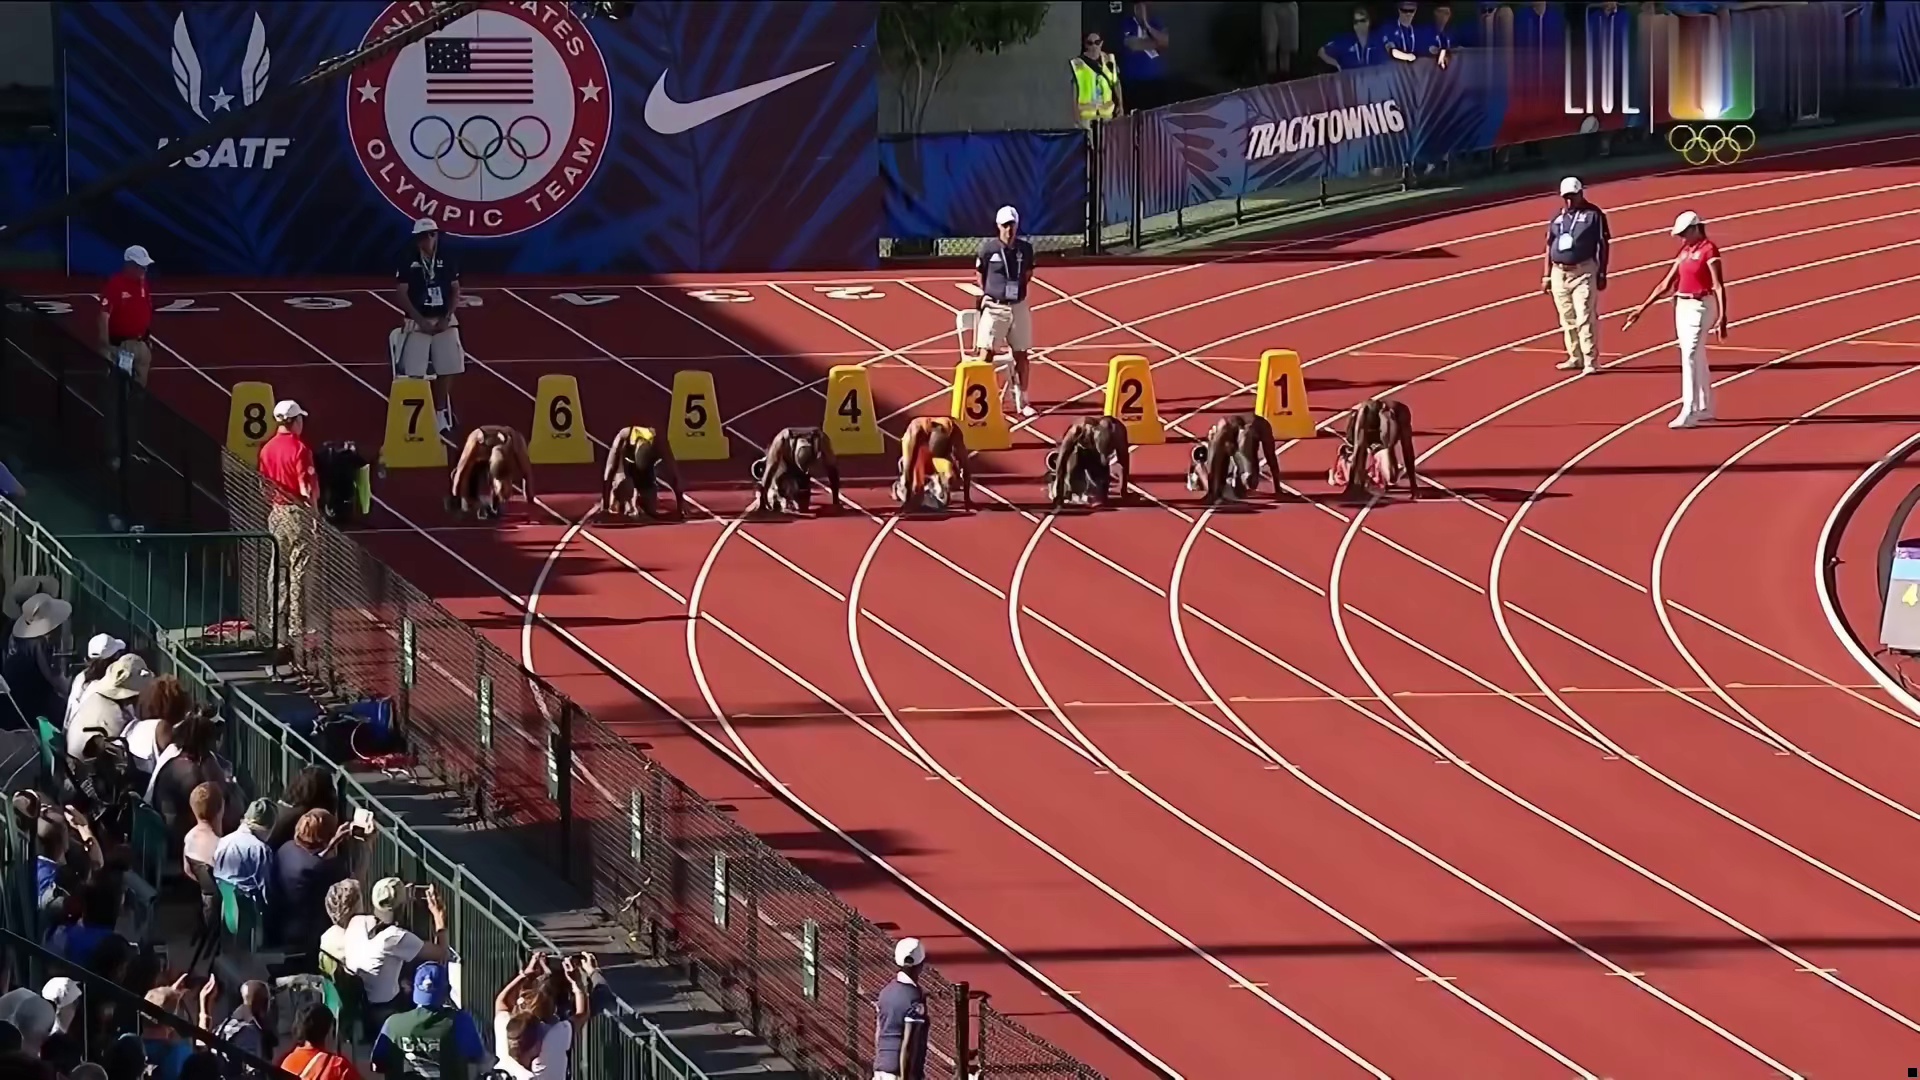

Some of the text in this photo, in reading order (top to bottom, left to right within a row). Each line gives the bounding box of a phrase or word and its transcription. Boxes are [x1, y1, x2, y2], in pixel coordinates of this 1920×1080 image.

[1245, 100, 1405, 160] TRACKTOWN16
[367, 137, 596, 227] OLYMPIC TEAM
[837, 388, 862, 424] 4
[965, 383, 989, 420] 3
[1120, 378, 1144, 414] 2
[1273, 373, 1289, 408] 1
[243, 402, 268, 440] 8
[402, 398, 425, 434] 7
[549, 395, 573, 432] 6
[684, 394, 708, 430] 5
